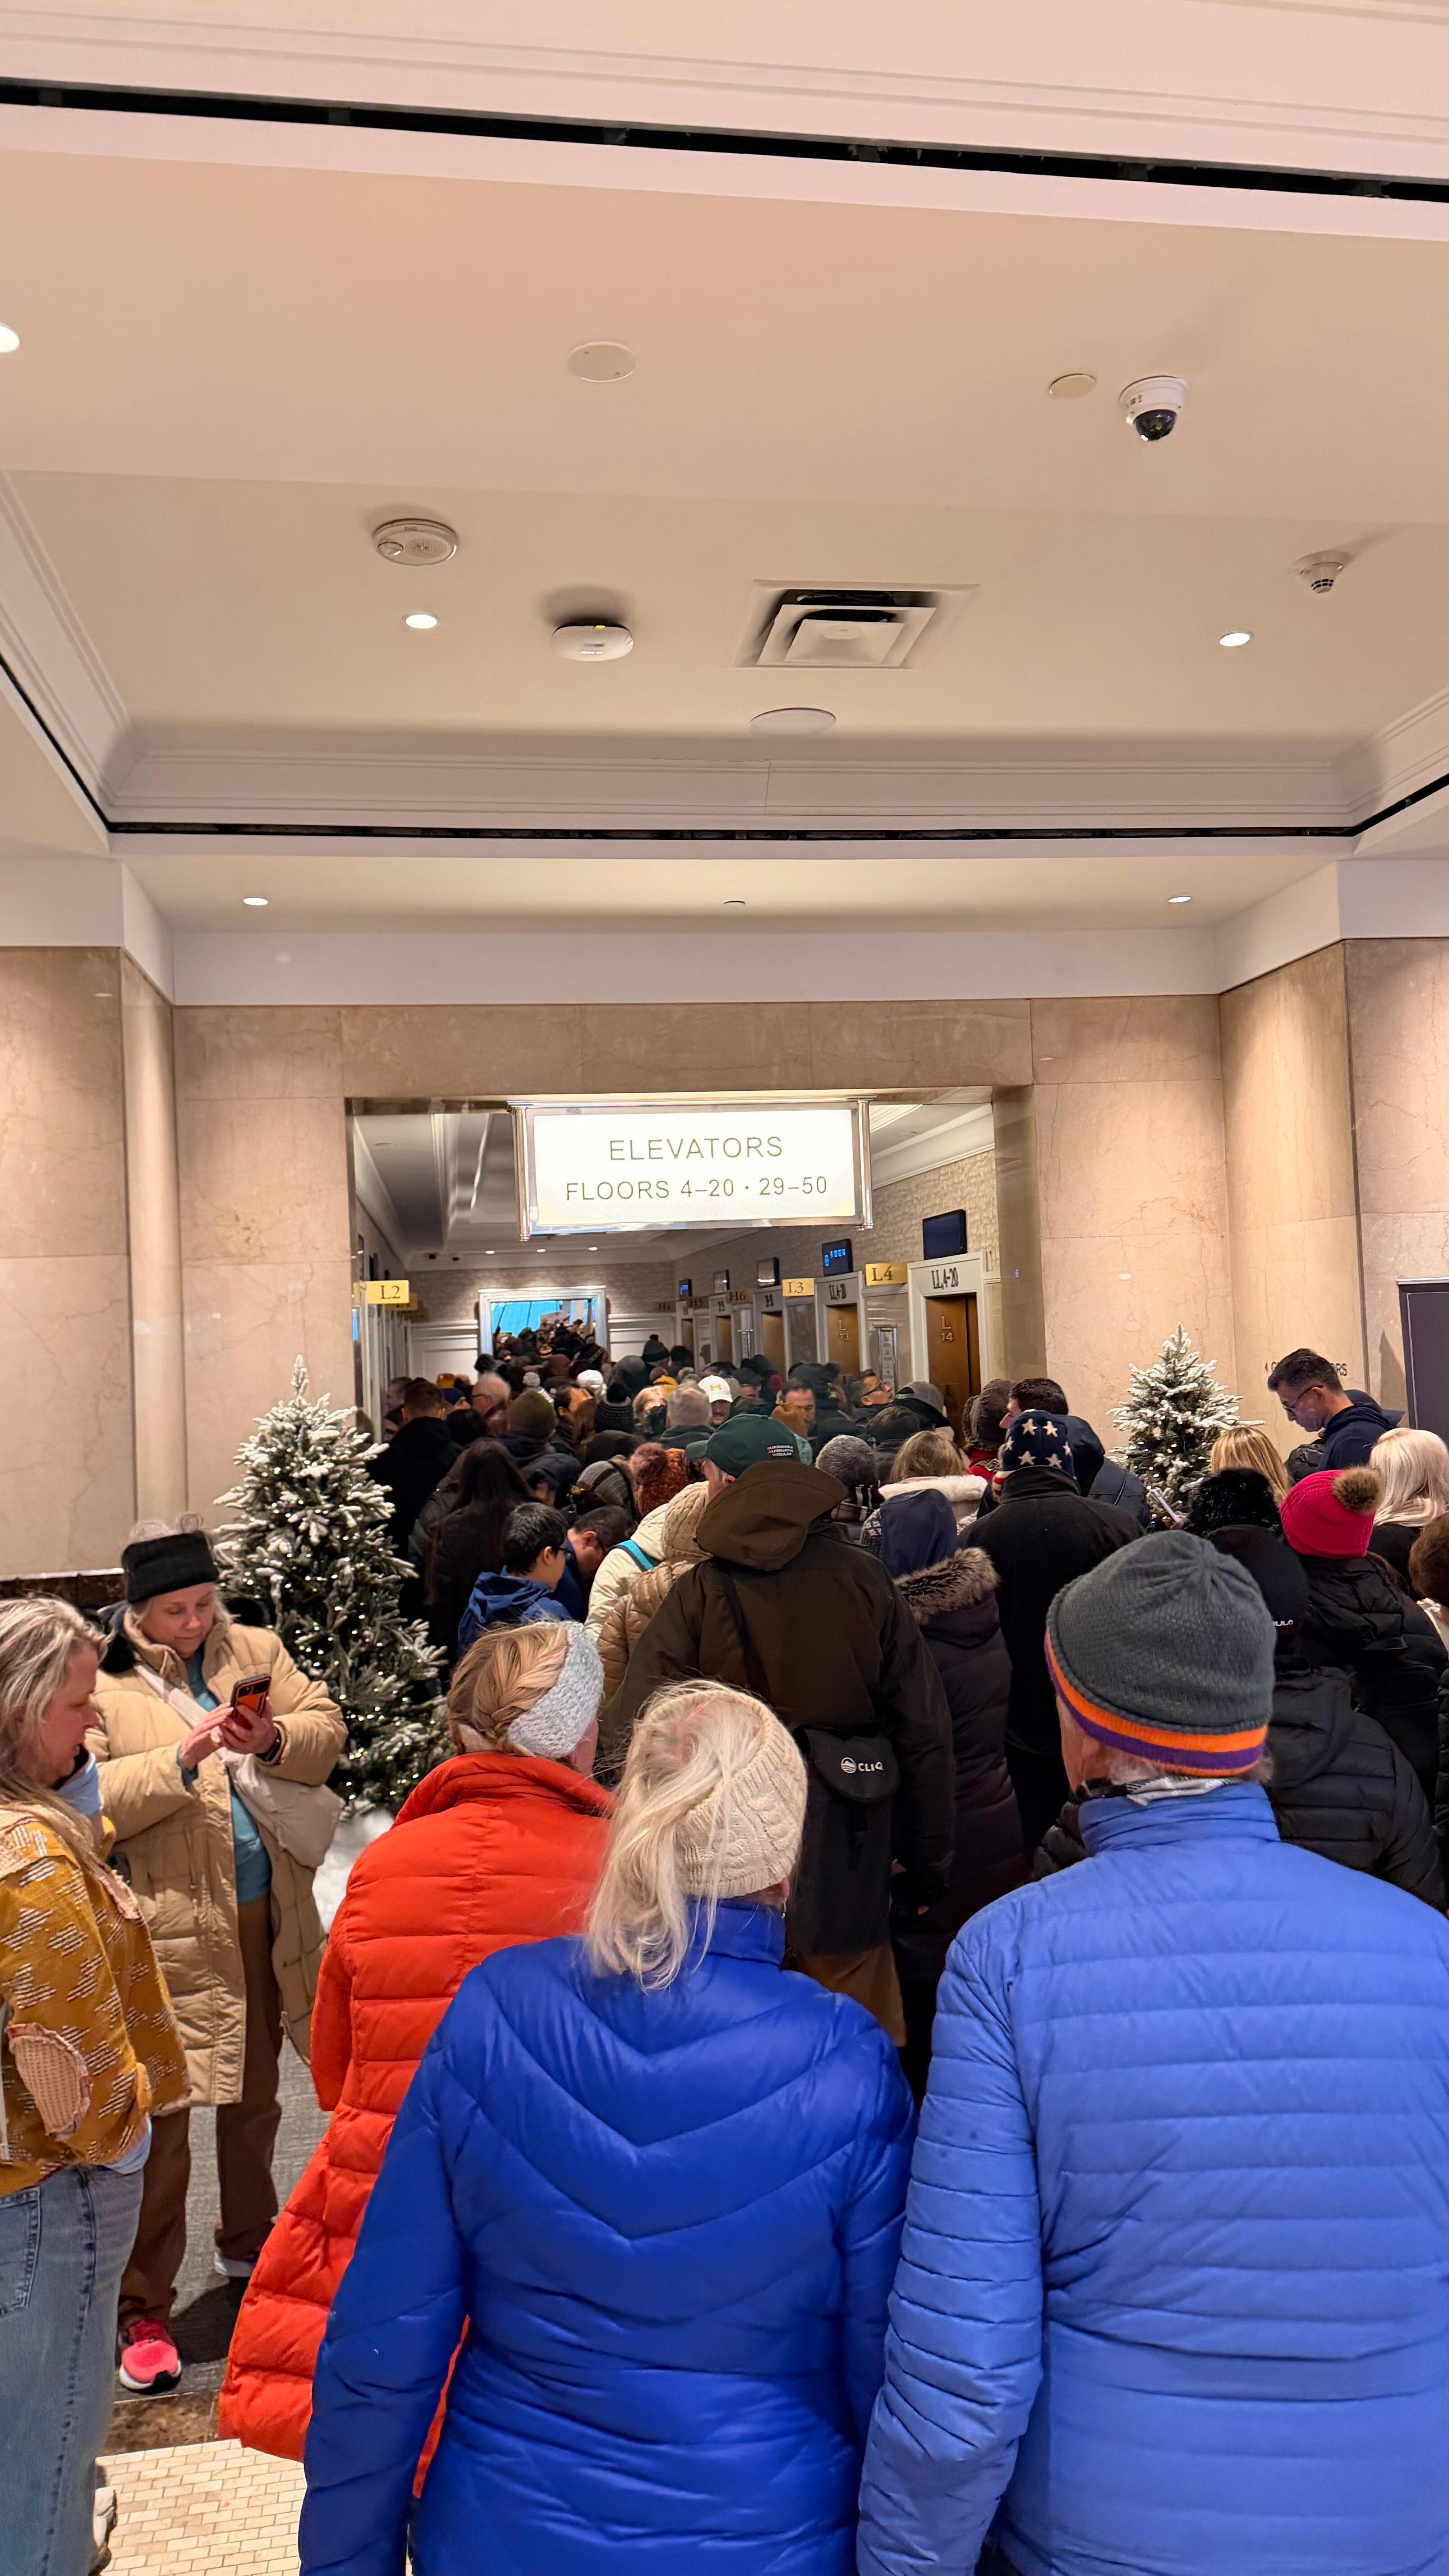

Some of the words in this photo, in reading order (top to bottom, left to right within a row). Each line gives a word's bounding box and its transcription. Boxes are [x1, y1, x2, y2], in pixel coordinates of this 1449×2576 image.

[610, 1136, 782, 1160] ELEVATORS
[566, 1180, 669, 1201] FLOORS
[681, 1178, 734, 1197] 4–20
[759, 1176, 827, 1195] 29–50
[871, 1266, 893, 1281] L4
[380, 1285, 401, 1299] L2
[788, 1282, 804, 1293] L3
[690, 1297, 703, 1307] H5
[729, 1290, 746, 1302] H6
[839, 1320, 847, 1330] L
[941, 1315, 952, 1330] L
[940, 1332, 954, 1342] 14
[857, 1761, 884, 1772] CLIQ
